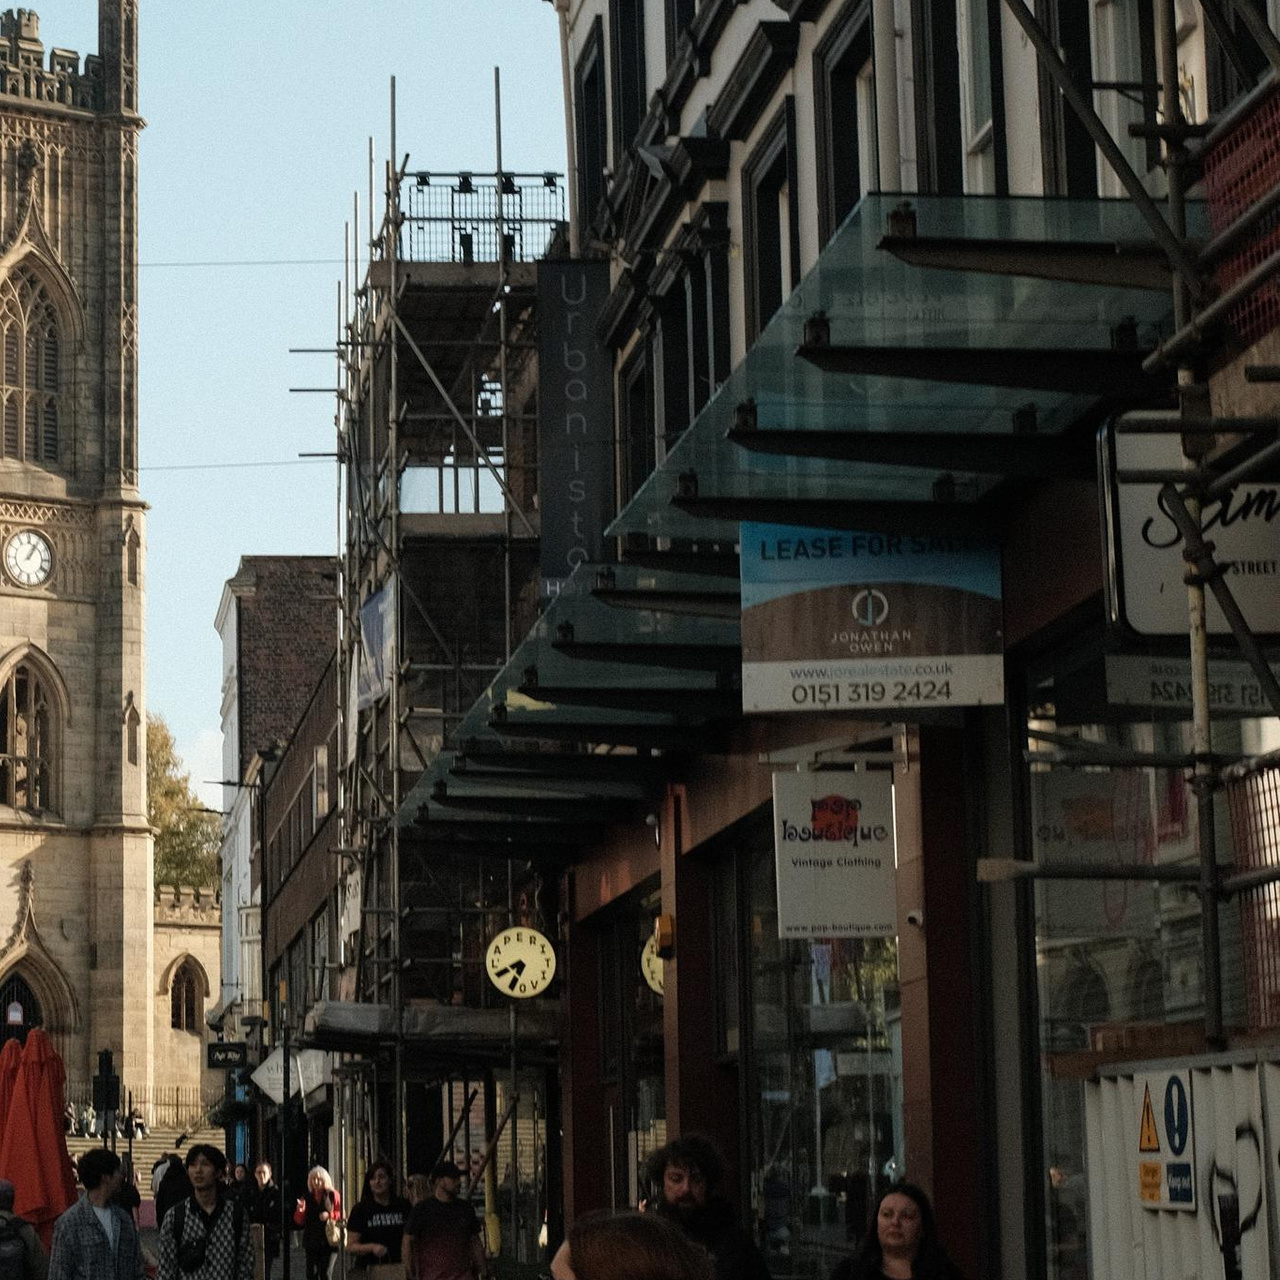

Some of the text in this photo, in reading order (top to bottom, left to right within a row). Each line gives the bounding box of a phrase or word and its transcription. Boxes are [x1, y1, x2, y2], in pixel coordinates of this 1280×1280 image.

[760, 535, 843, 561] LEASE
[851, 534, 903, 557] FOR
[1232, 561, 1277, 575] STREET
[831, 629, 912, 644] JONATHAN
[849, 641, 894, 654] OWEN
[792, 680, 951, 704] 0151 319 2424
[791, 856, 882, 869] Vintage Clothing
